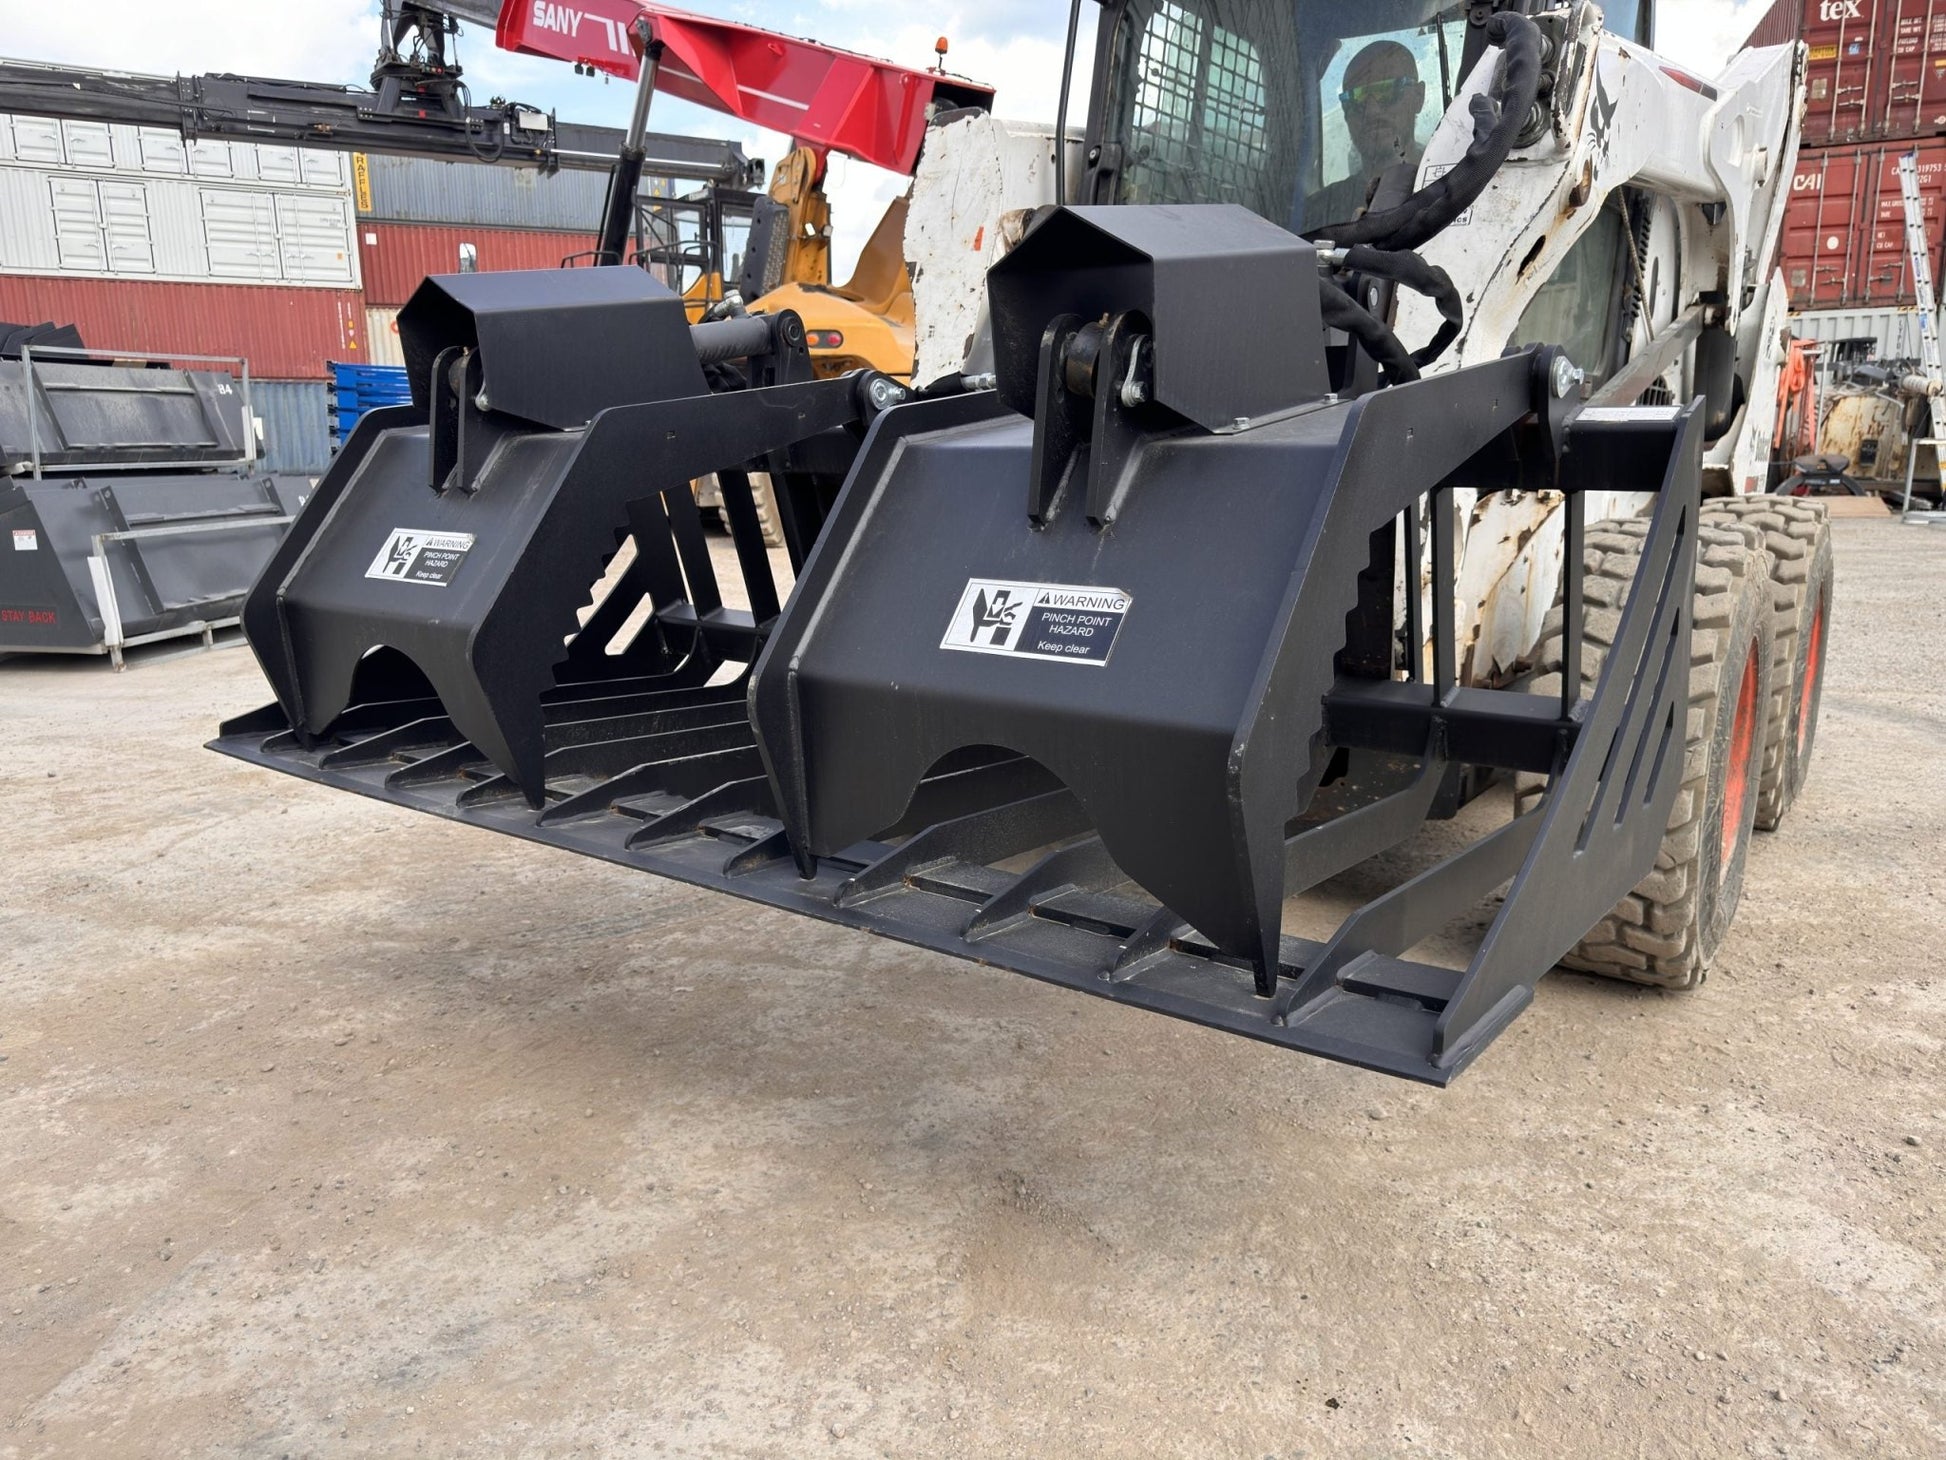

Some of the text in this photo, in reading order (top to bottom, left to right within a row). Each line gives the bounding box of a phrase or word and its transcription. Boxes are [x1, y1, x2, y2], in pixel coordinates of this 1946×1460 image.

[1820, 0, 1861, 21] tex
[532, 0, 583, 37] SANY
[356, 156, 369, 209] RAFFLES
[1793, 173, 1822, 191] CAI
[434, 539, 470, 550] WARNING
[424, 551, 441, 559] PINCH
[424, 560, 449, 568] HAZARD
[416, 570, 429, 579] Keep
[1053, 594, 1125, 610] WARNING
[1, 609, 57, 624] STAY BACK
[1041, 612, 1112, 627] PINCH POINT
[1049, 624, 1094, 637] HAZARD
[1037, 640, 1090, 654] Keep clear
